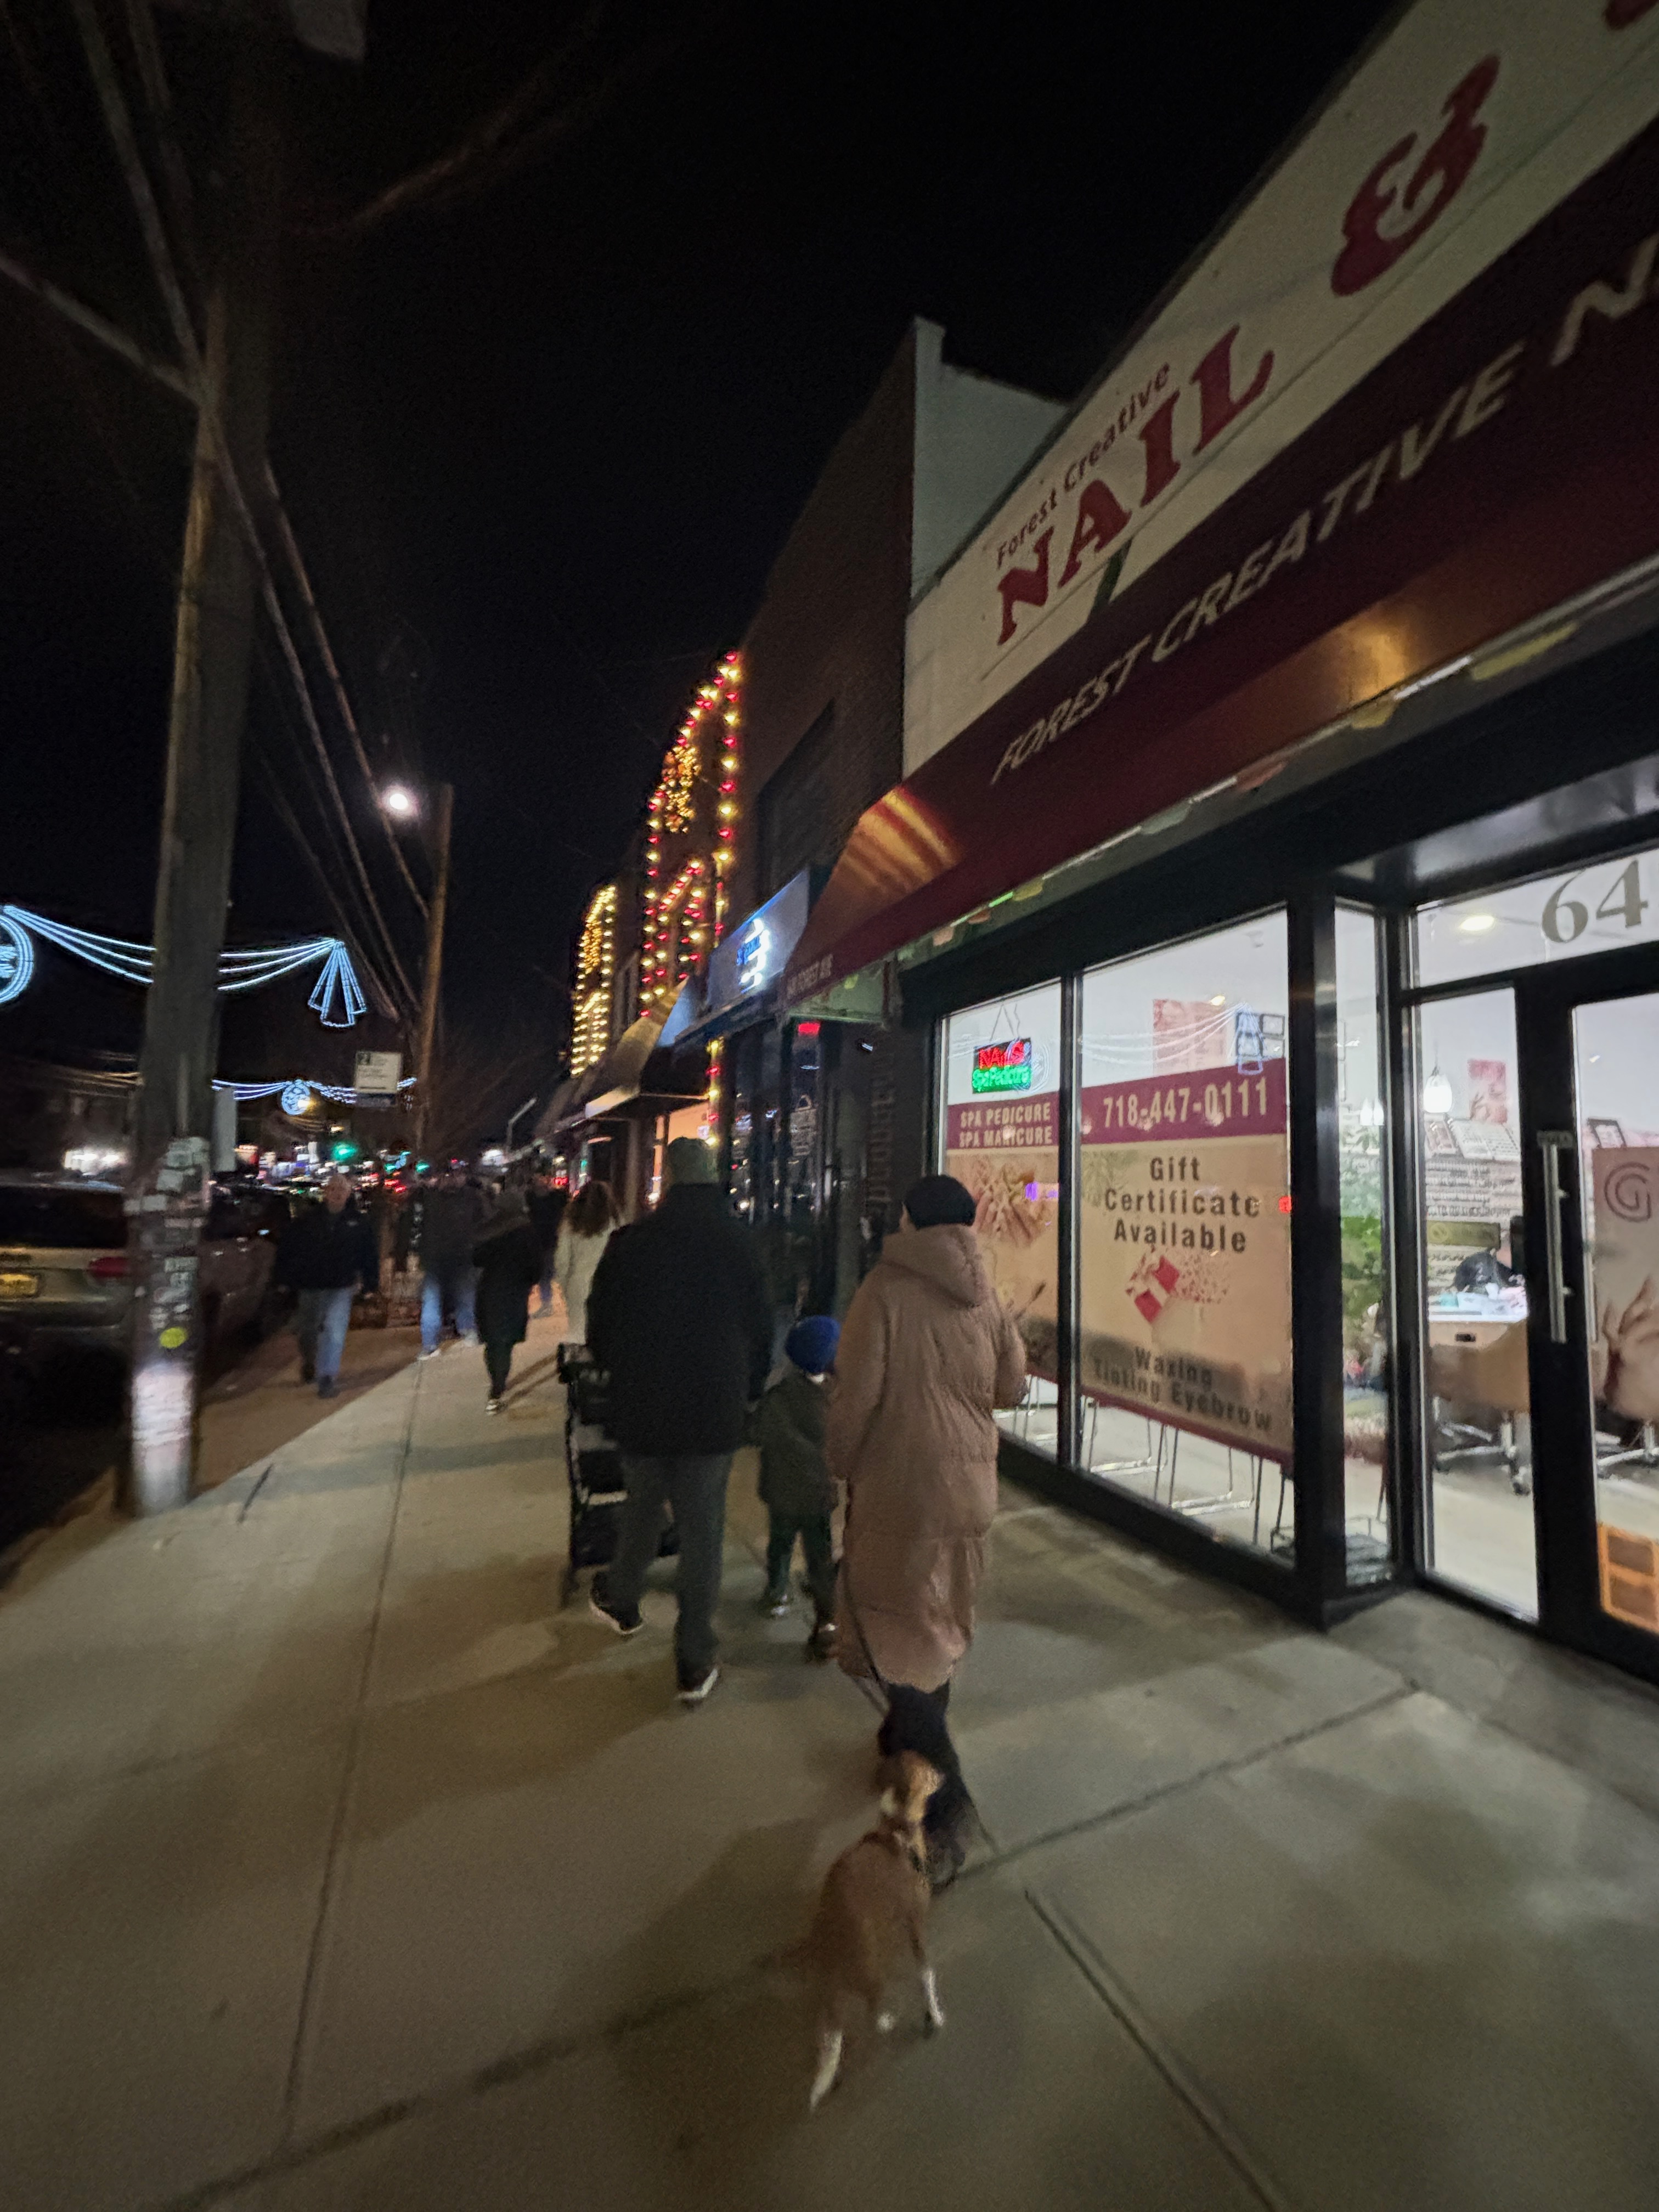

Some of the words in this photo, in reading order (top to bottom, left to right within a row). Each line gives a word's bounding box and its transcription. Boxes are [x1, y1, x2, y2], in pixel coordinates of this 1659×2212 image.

[996, 324, 1275, 646] NAIL
[1329, 54, 1502, 297] &
[996, 488, 1057, 570] Forest
[1064, 363, 1170, 492] Creative
[991, 634, 1154, 786] FOREST
[1150, 340, 1528, 663] CREATIVE
[1542, 859, 1649, 945] 64
[960, 1110, 982, 1128] SPA
[985, 1102, 1051, 1126] PEDICURE
[1103, 1076, 1267, 1128] 718-447-0111
[1150, 1156, 1200, 1182] Gift
[1104, 1188, 1261, 1217] Certificate
[1113, 1217, 1246, 1254] Available
